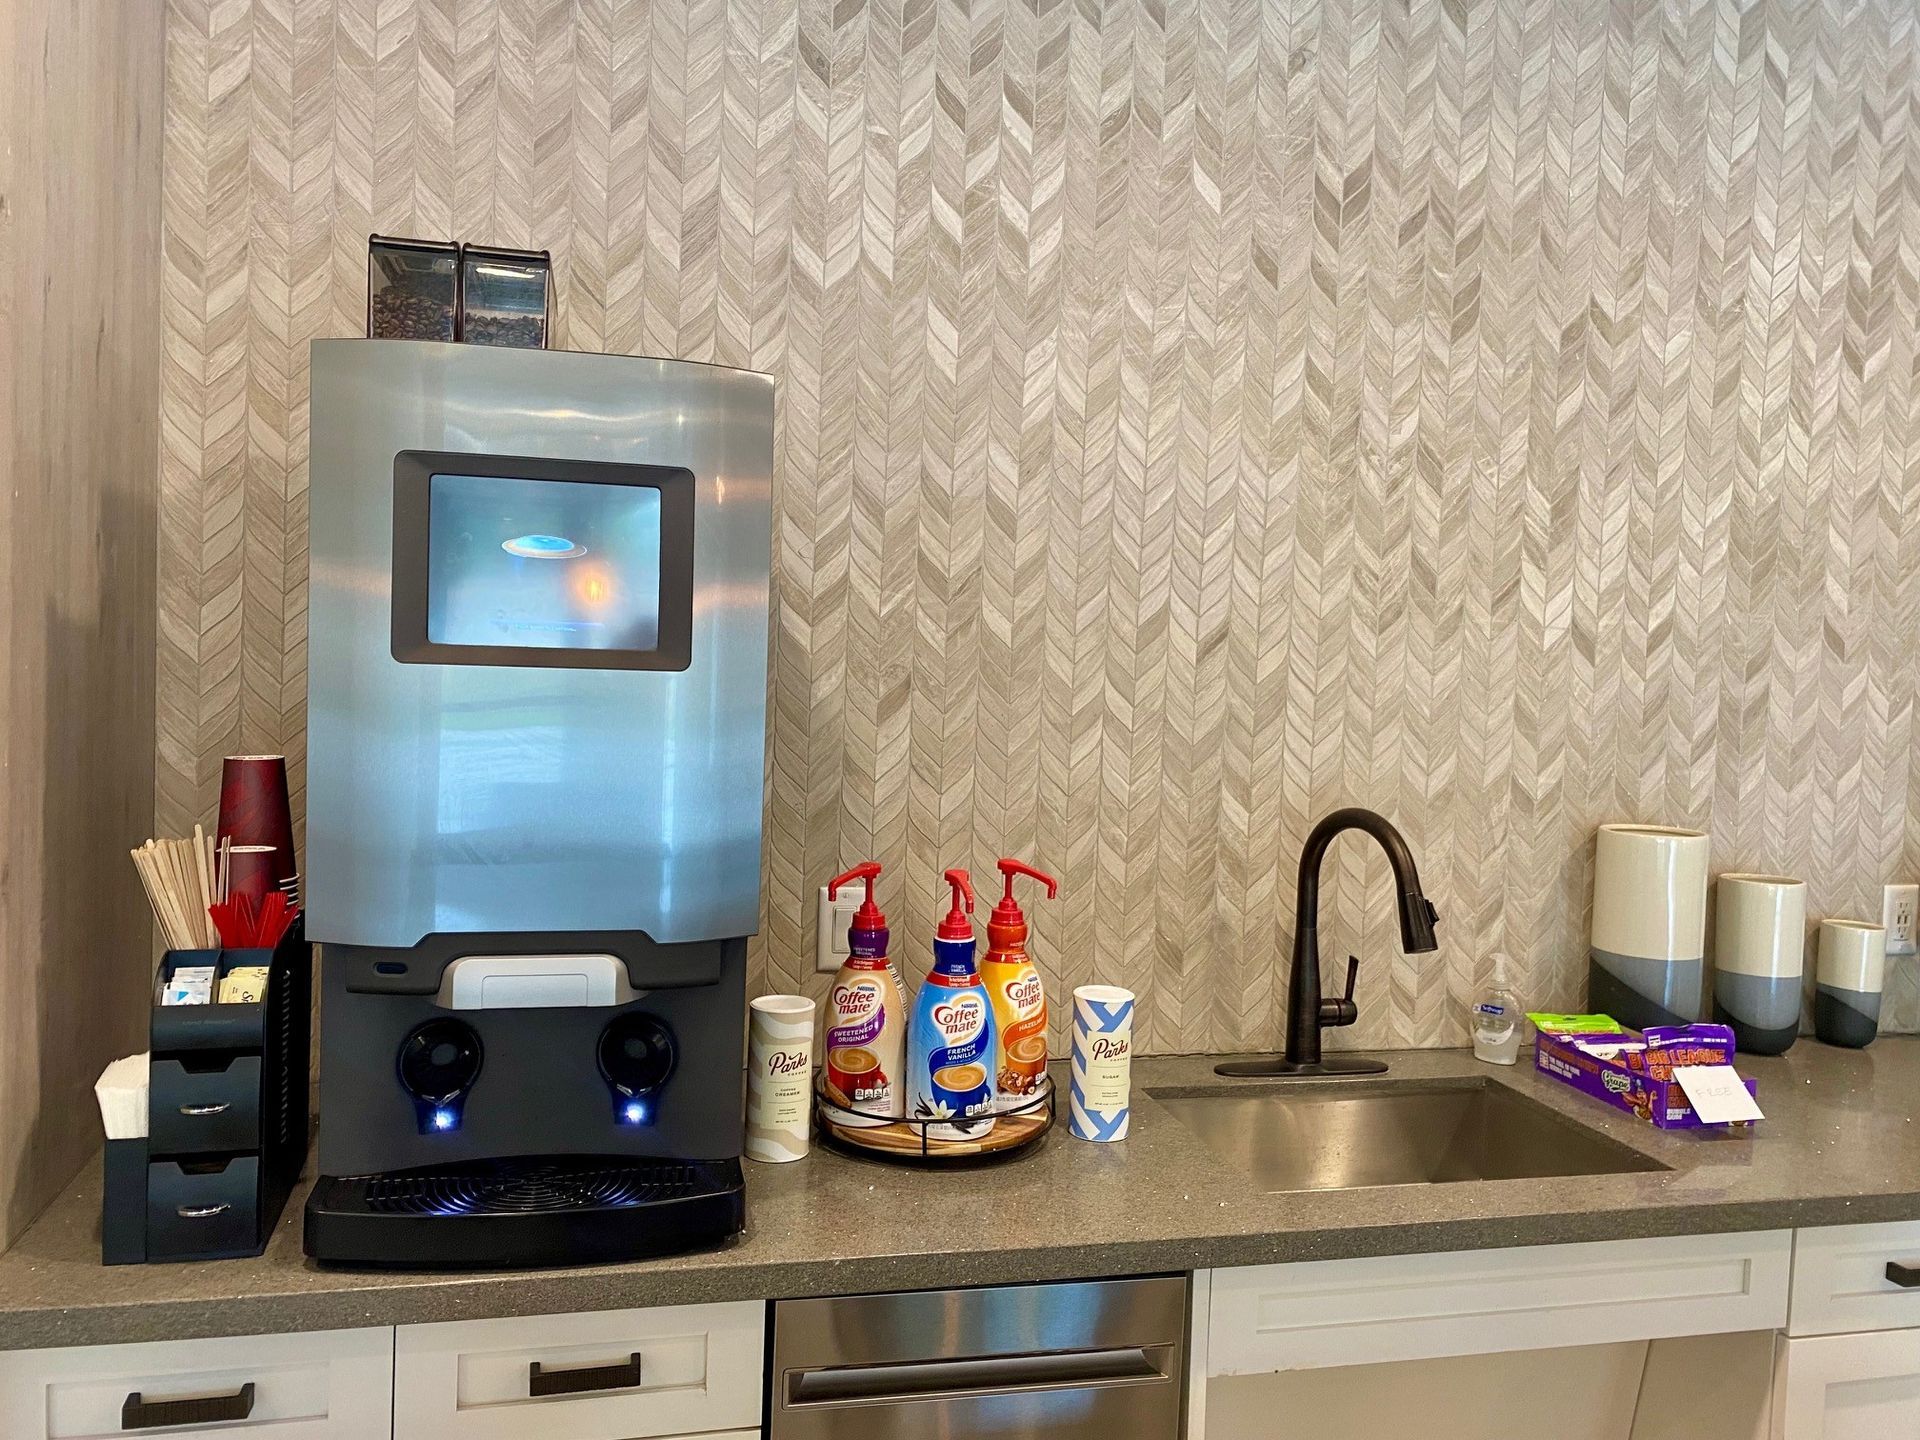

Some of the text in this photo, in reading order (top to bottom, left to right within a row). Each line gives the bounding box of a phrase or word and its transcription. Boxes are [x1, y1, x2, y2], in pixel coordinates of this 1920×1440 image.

[834, 985, 875, 1006] Coffee
[1005, 982, 1040, 1001] Coffee
[838, 1003, 871, 1015] mate
[1018, 993, 1041, 1009] mate
[934, 1005, 979, 1026] Coffee
[833, 1024, 874, 1038] SWEETENED
[945, 1020, 977, 1034] mate
[838, 1034, 869, 1043] ORIGINAL
[947, 1043, 976, 1055] FRENCH
[947, 1050, 977, 1061] VANILLA
[1092, 1038, 1129, 1061] Parks
[1645, 1048, 1727, 1065] BIG LEAGUE
[768, 1051, 808, 1076] Parks
